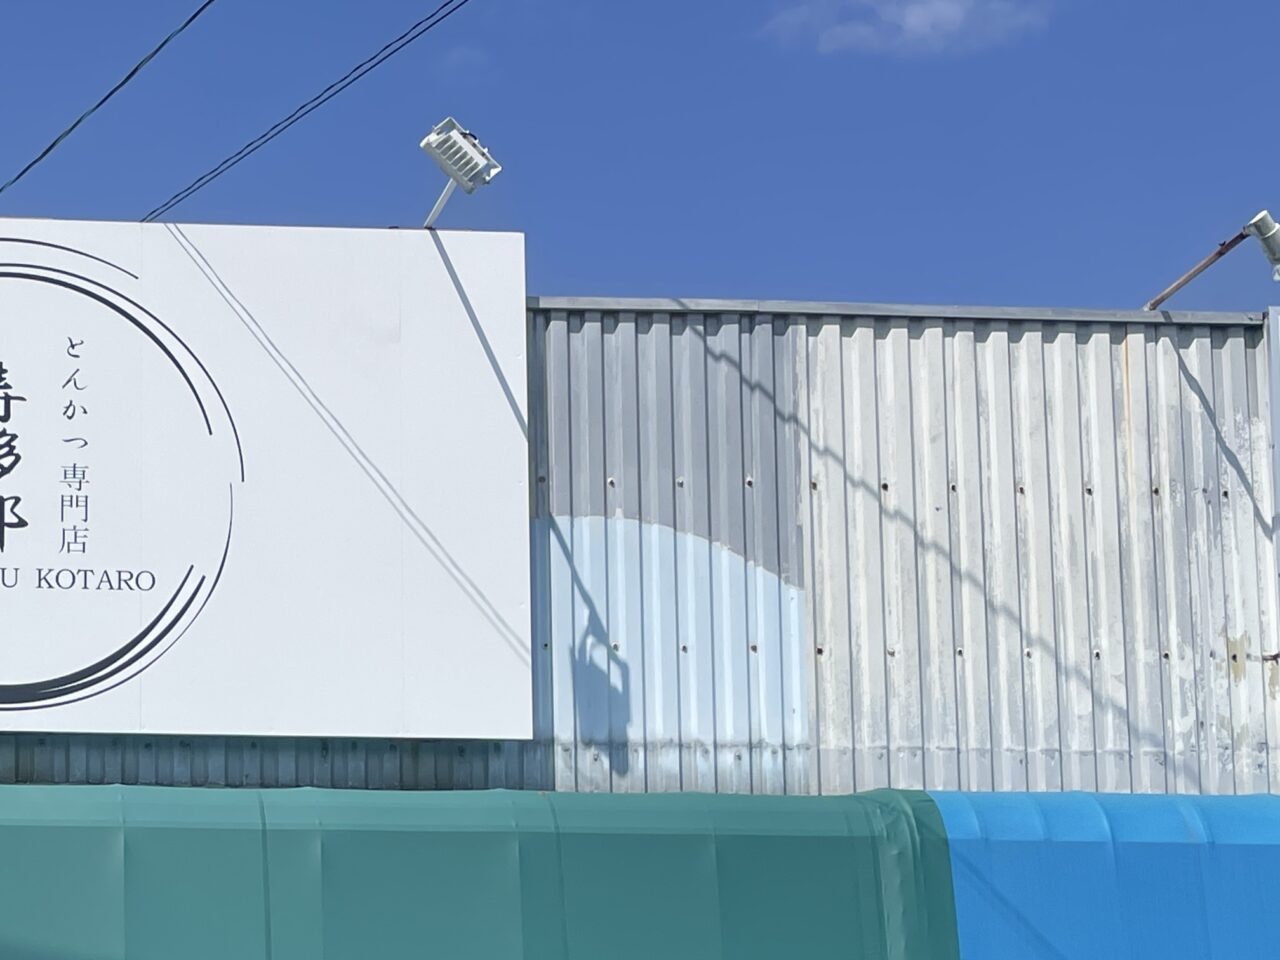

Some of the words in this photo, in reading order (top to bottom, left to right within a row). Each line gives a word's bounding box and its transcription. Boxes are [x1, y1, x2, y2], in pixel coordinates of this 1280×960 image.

[58, 336, 90, 555] とんかつ専門店
[35, 569, 157, 592] KOTARO
